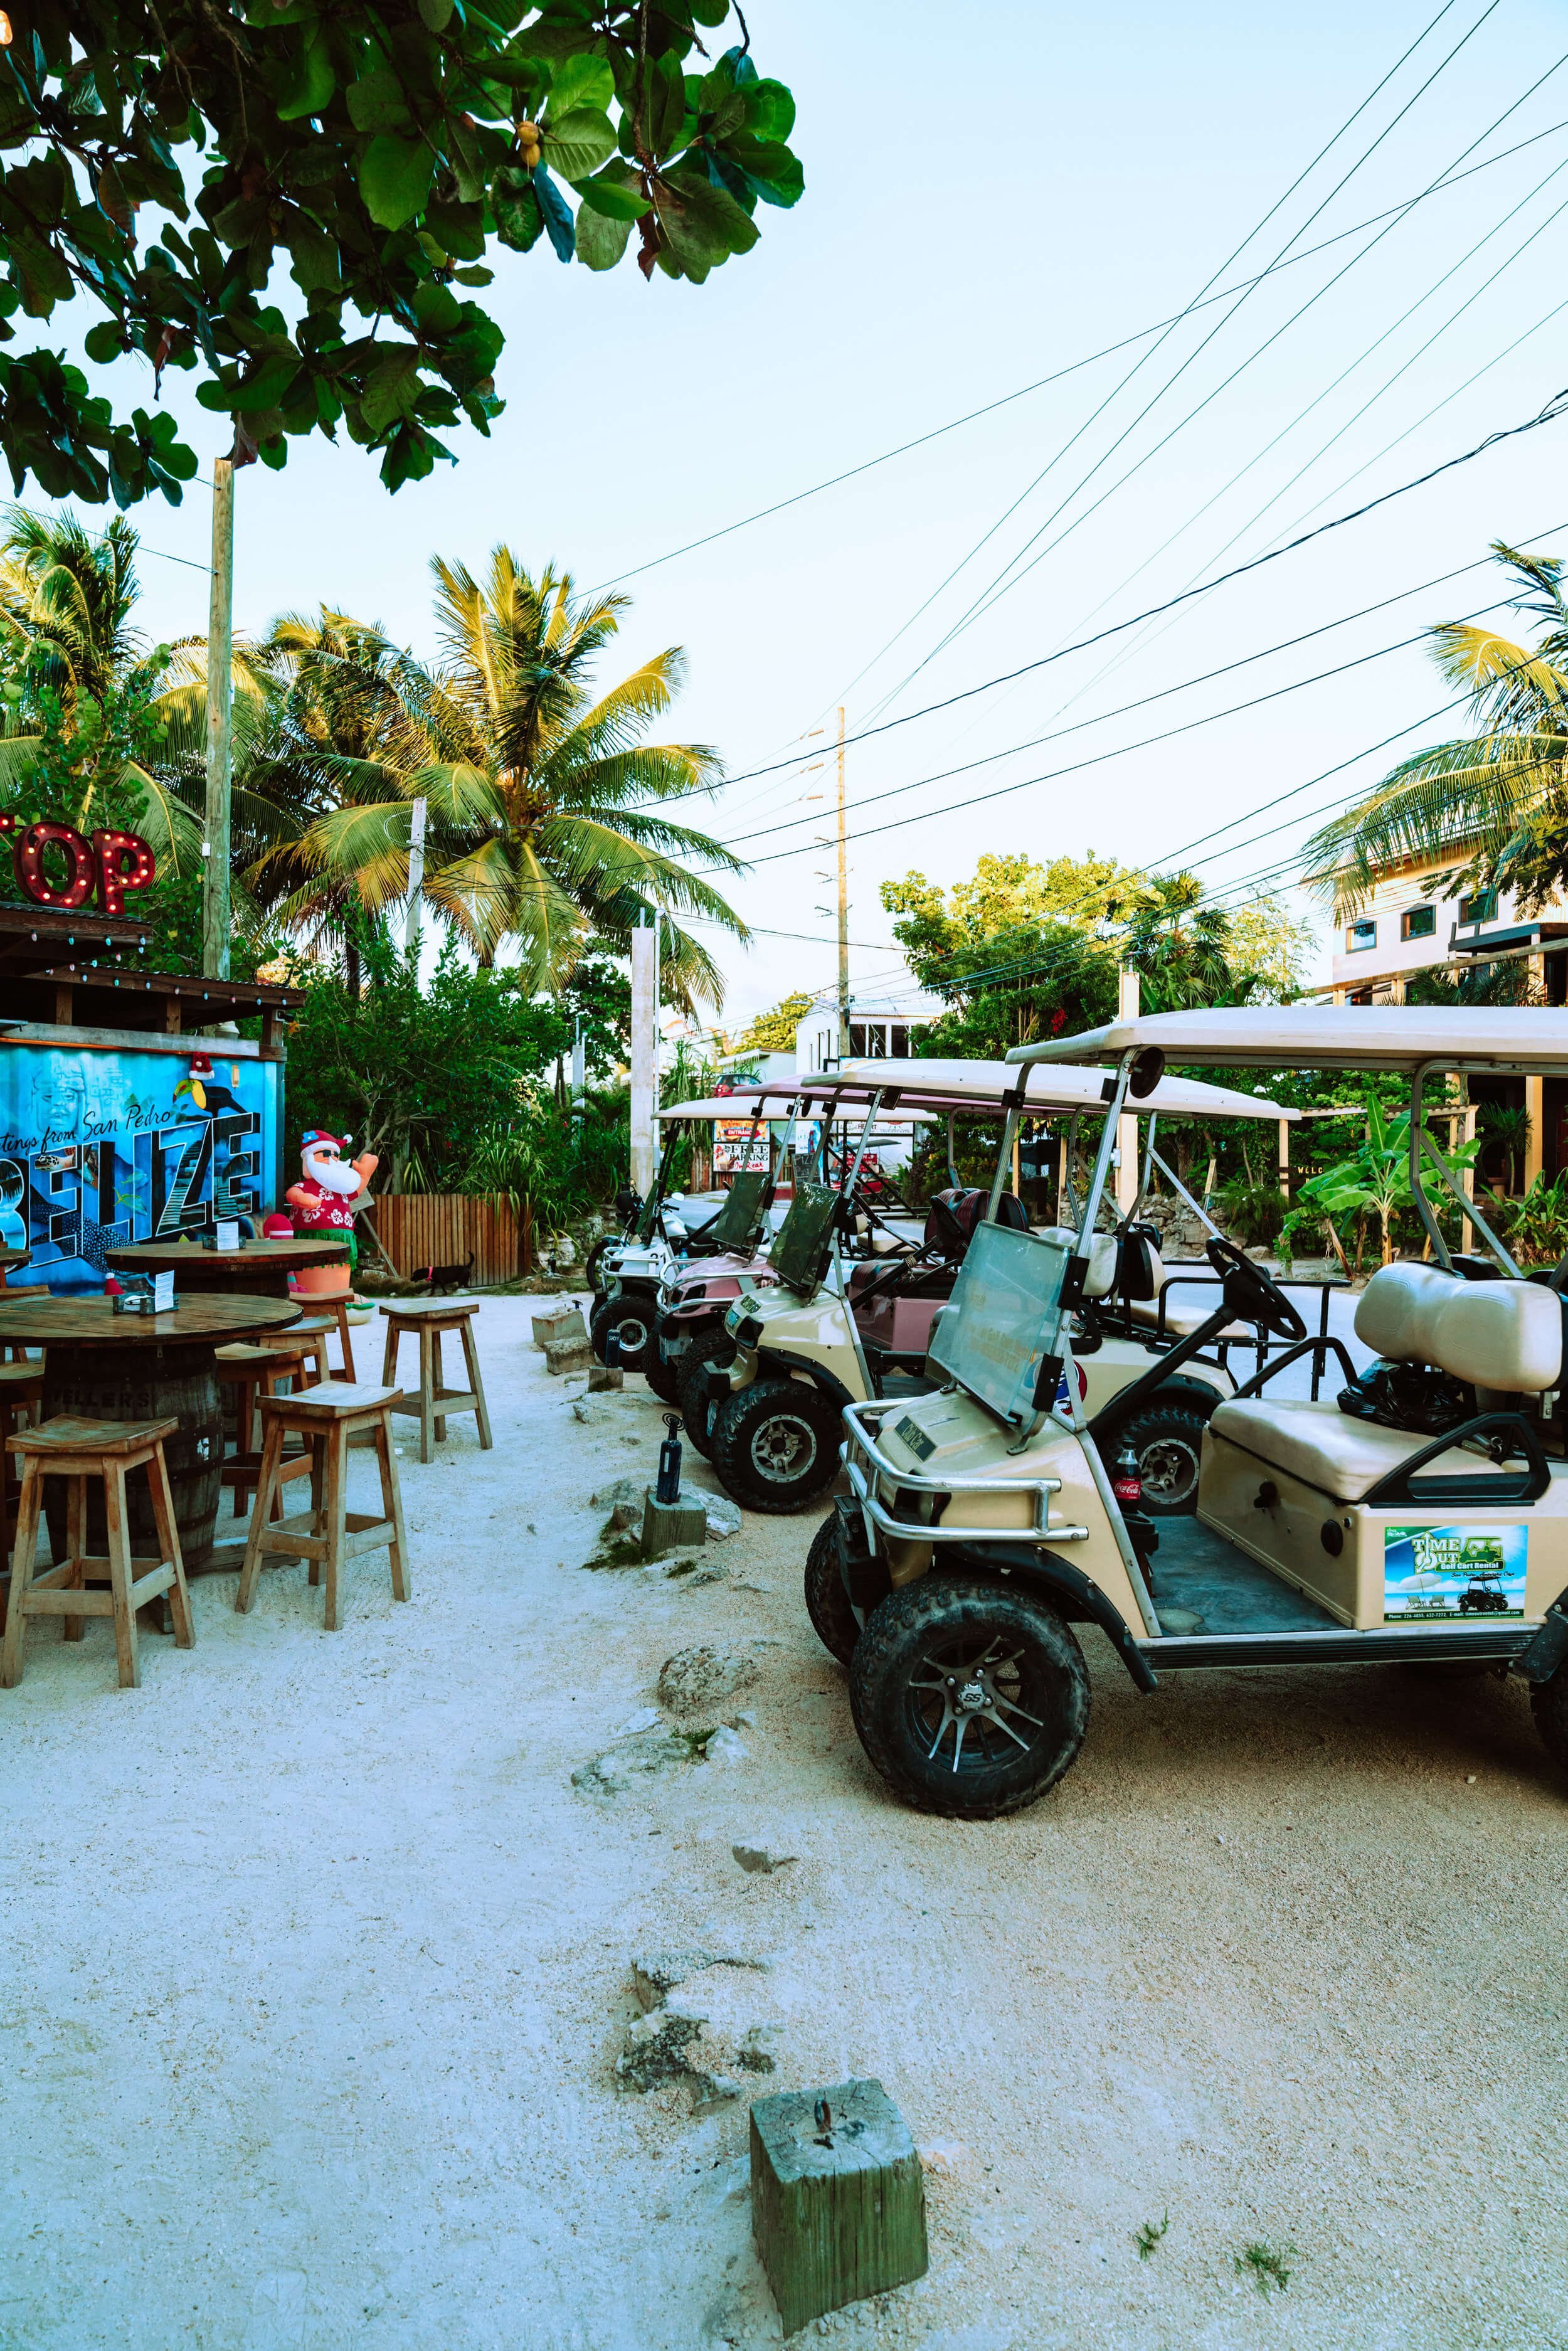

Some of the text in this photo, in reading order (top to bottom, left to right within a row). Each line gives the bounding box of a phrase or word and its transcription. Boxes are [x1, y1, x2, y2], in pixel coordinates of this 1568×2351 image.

[0, 814, 156, 914] OP
[0, 1104, 172, 1154] tings from San Pedro
[901, 1423, 924, 1450] Club Car
[1412, 1538, 1459, 1551] TIME
[1416, 1552, 1458, 1571] OUT
[963, 1693, 982, 1702] SS
